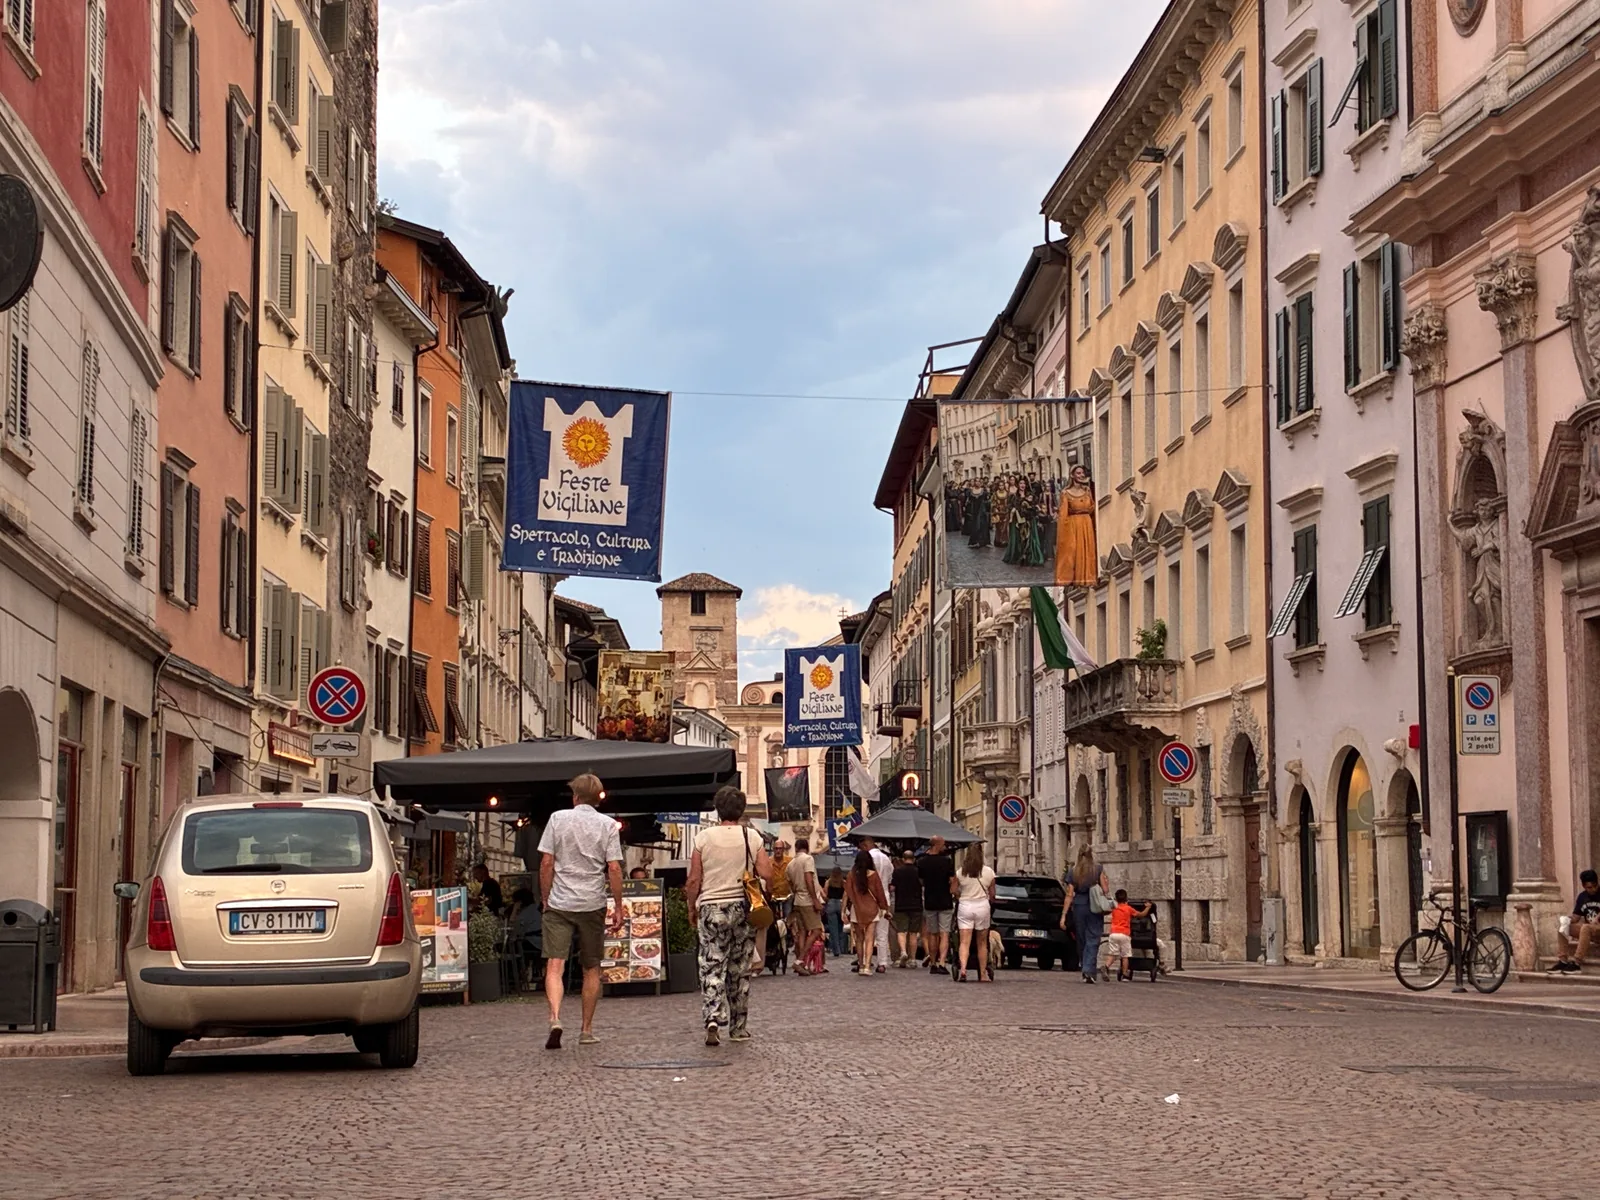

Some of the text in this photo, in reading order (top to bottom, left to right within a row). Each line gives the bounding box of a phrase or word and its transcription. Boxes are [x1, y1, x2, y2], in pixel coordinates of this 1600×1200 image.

[559, 469, 611, 493] Feste
[542, 490, 626, 520] Vigiliane
[509, 523, 652, 554] Spettacolo, Cultura
[537, 547, 623, 569] e Tradizione
[809, 691, 836, 703] Feste
[801, 703, 843, 718] Vigiliane
[787, 721, 858, 734] Spettacolo, Cultura
[808, 732, 844, 742] Tradizione
[241, 913, 260, 929] CV
[266, 912, 314, 929] 811MY
